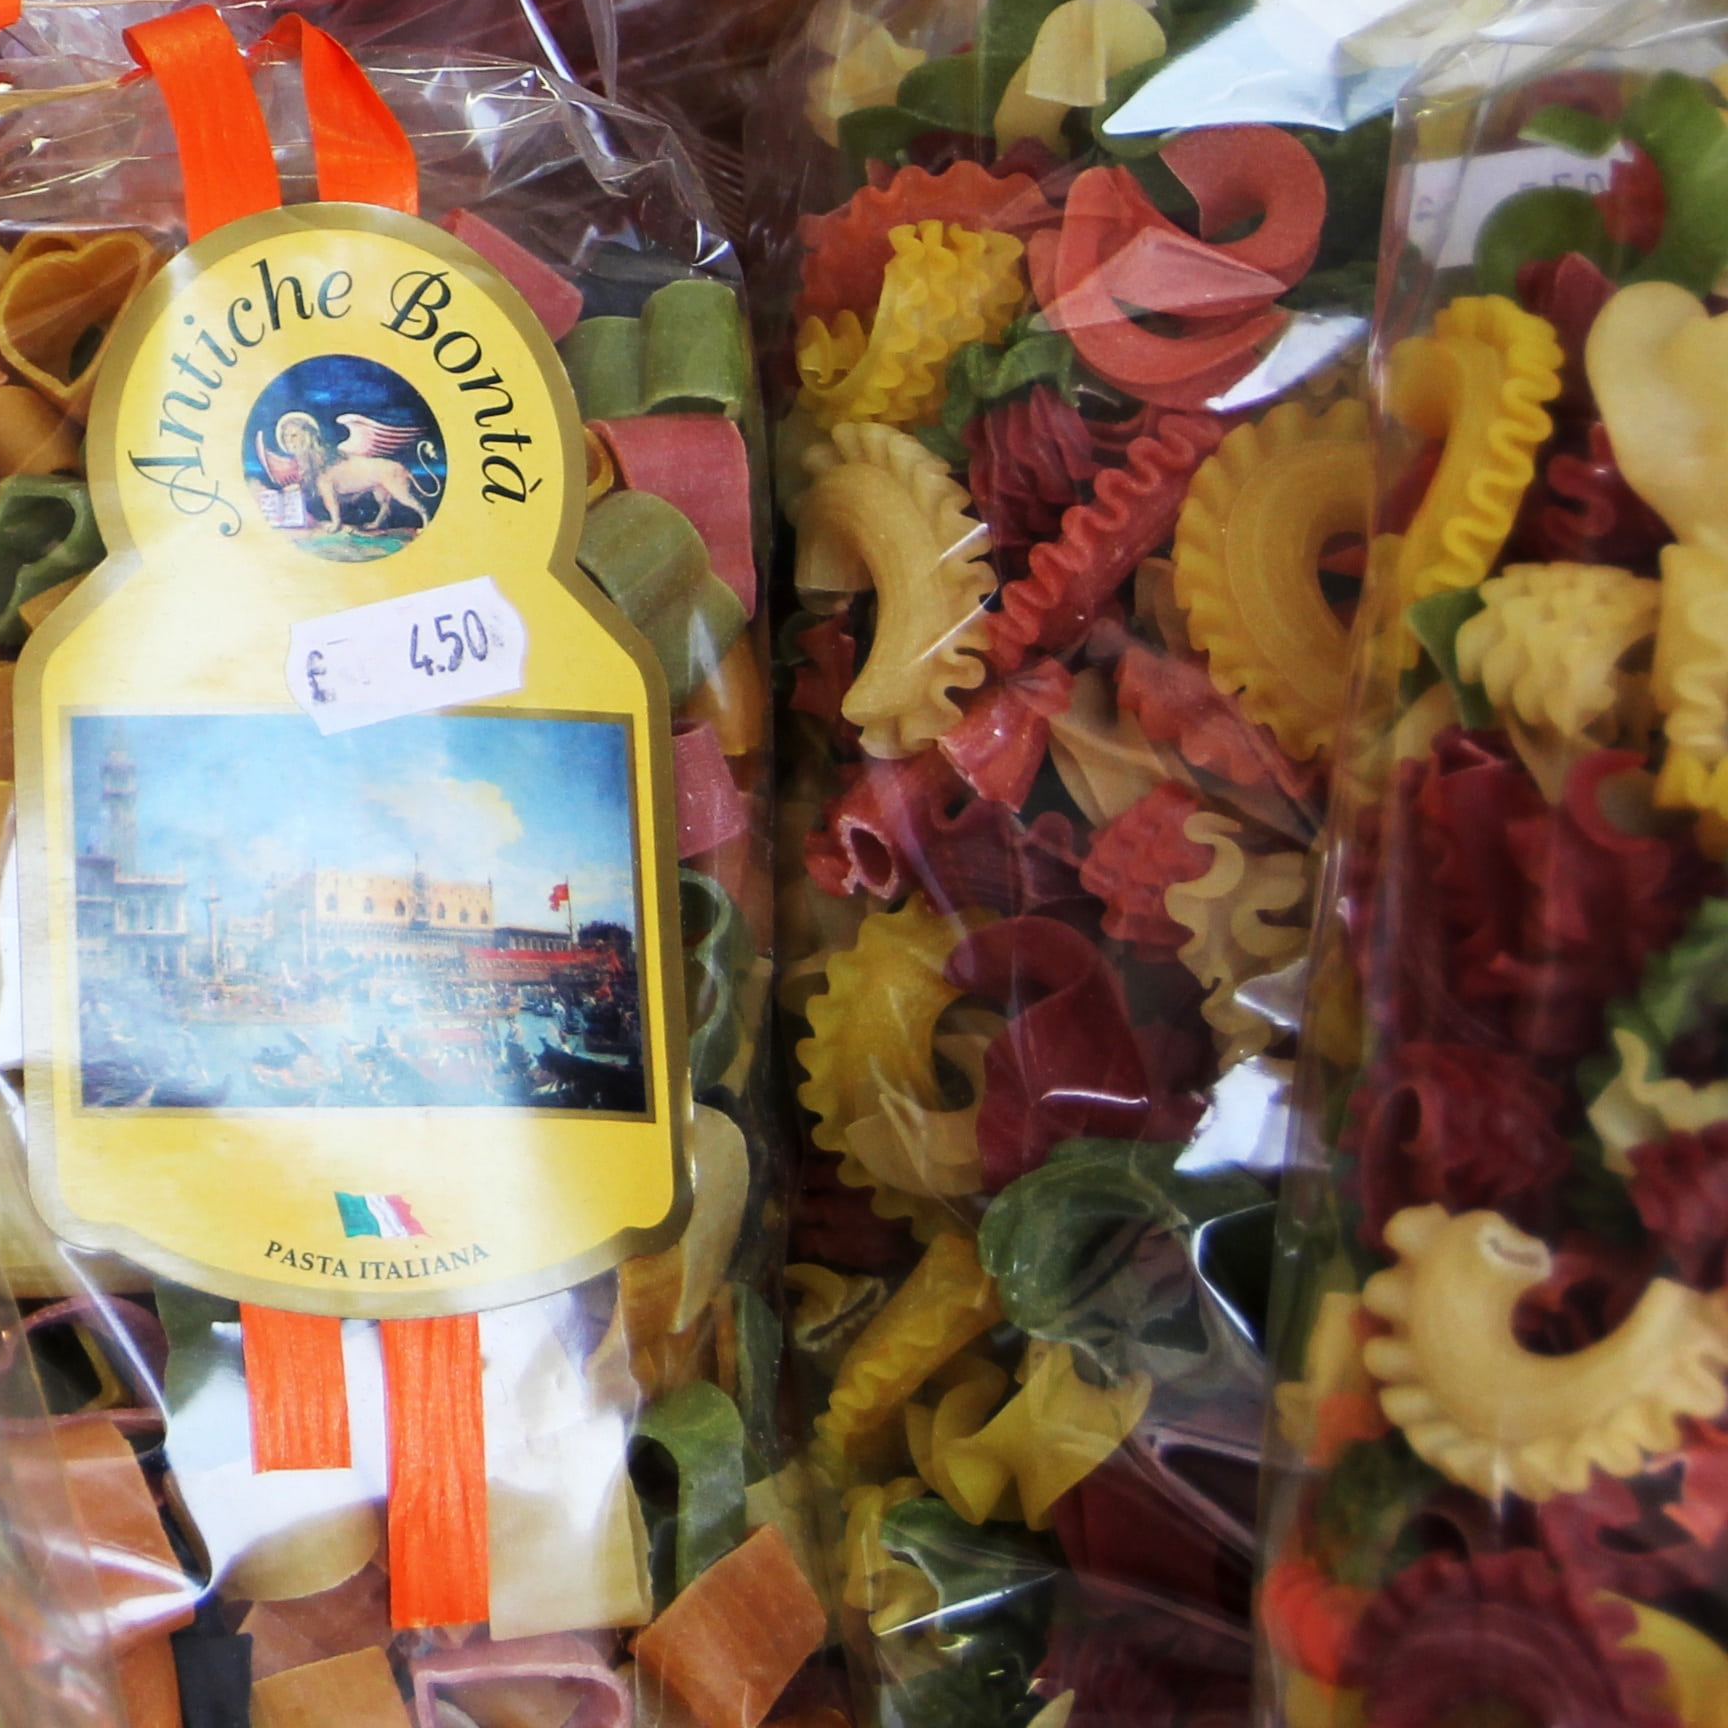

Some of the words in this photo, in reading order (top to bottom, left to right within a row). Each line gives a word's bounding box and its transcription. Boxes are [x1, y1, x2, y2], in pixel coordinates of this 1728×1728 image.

[127, 258, 353, 538] Antiche
[380, 270, 543, 504] Bontà
[409, 609, 488, 676] 4.50
[264, 1239, 349, 1278] PASTA
[359, 1242, 491, 1280] ITALIANA
